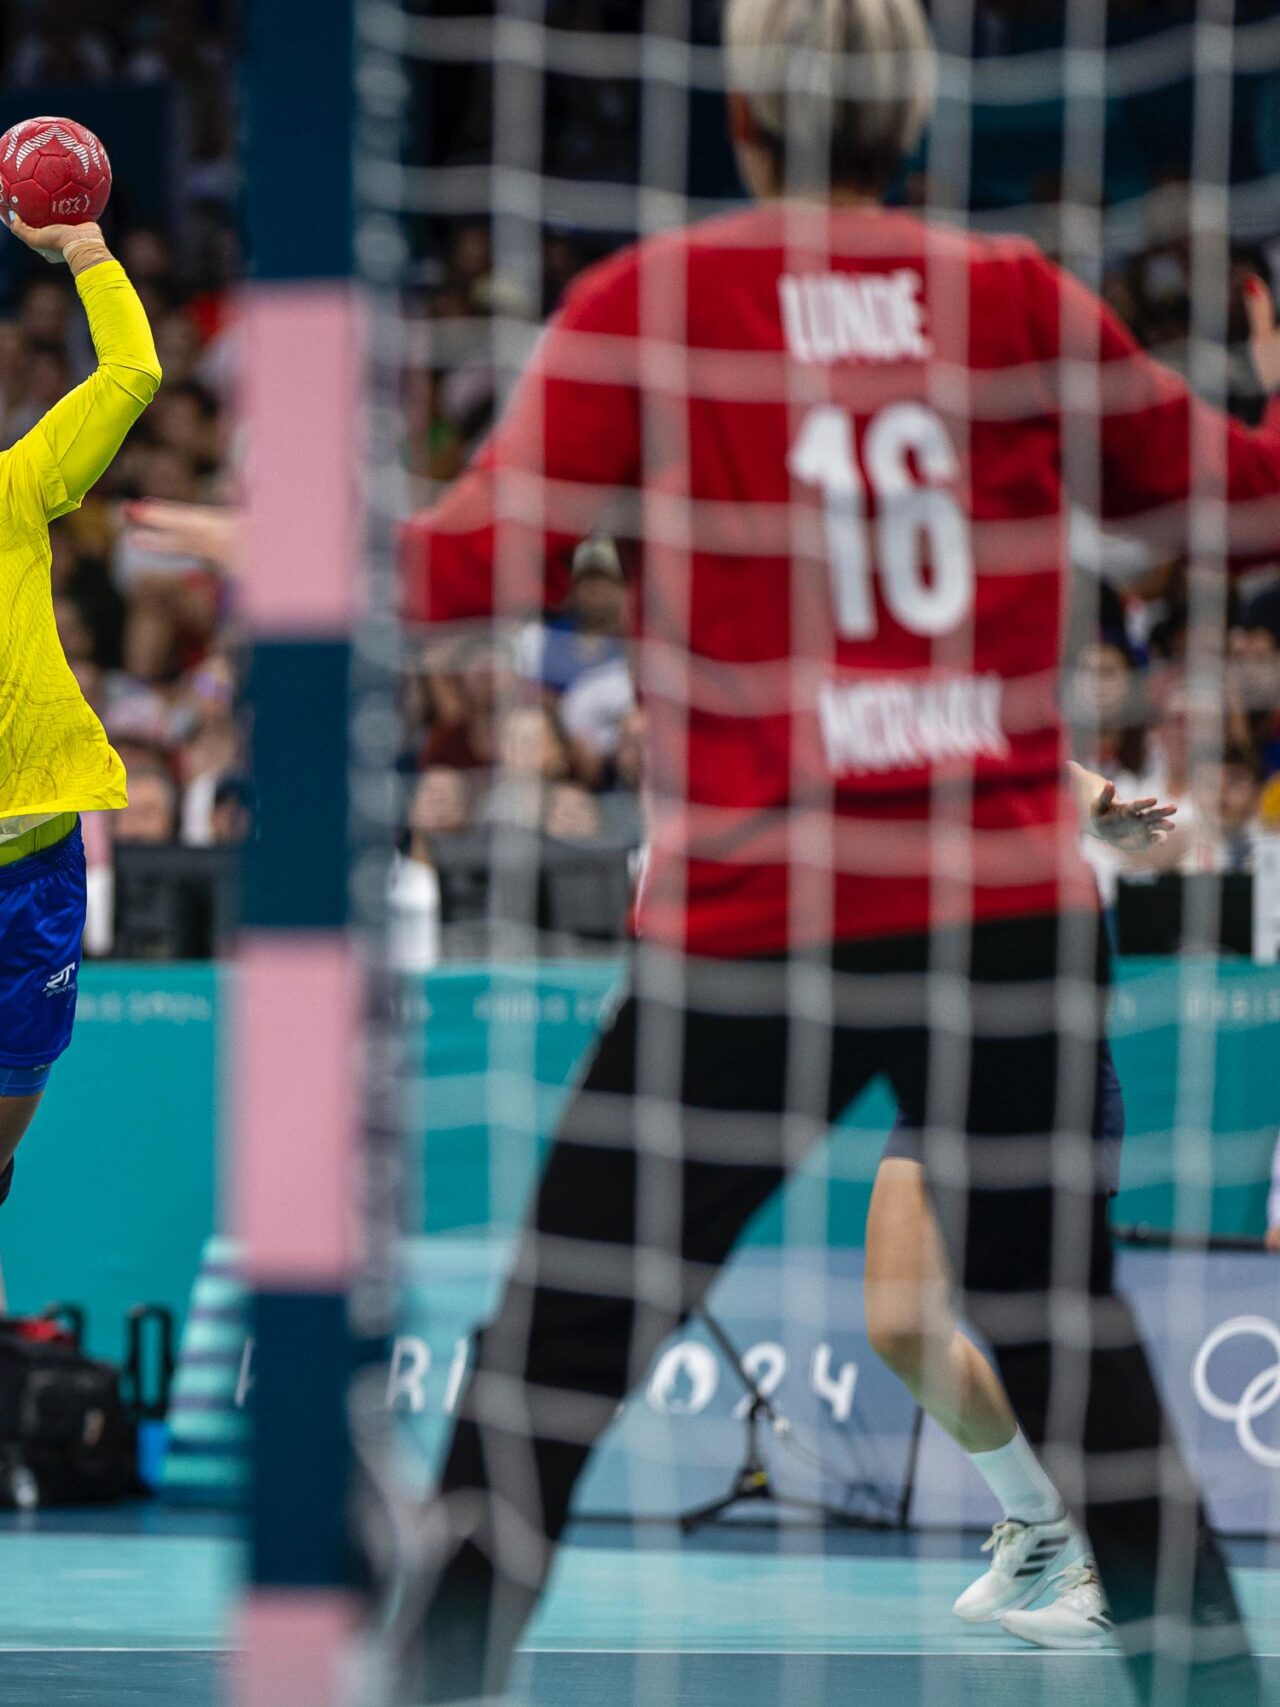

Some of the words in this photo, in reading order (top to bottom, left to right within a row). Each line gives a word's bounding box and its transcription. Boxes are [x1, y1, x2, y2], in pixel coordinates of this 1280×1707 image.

[777, 268, 934, 365] LUNDE
[789, 401, 975, 640] 16
[648, 1340, 858, 1423] 024
